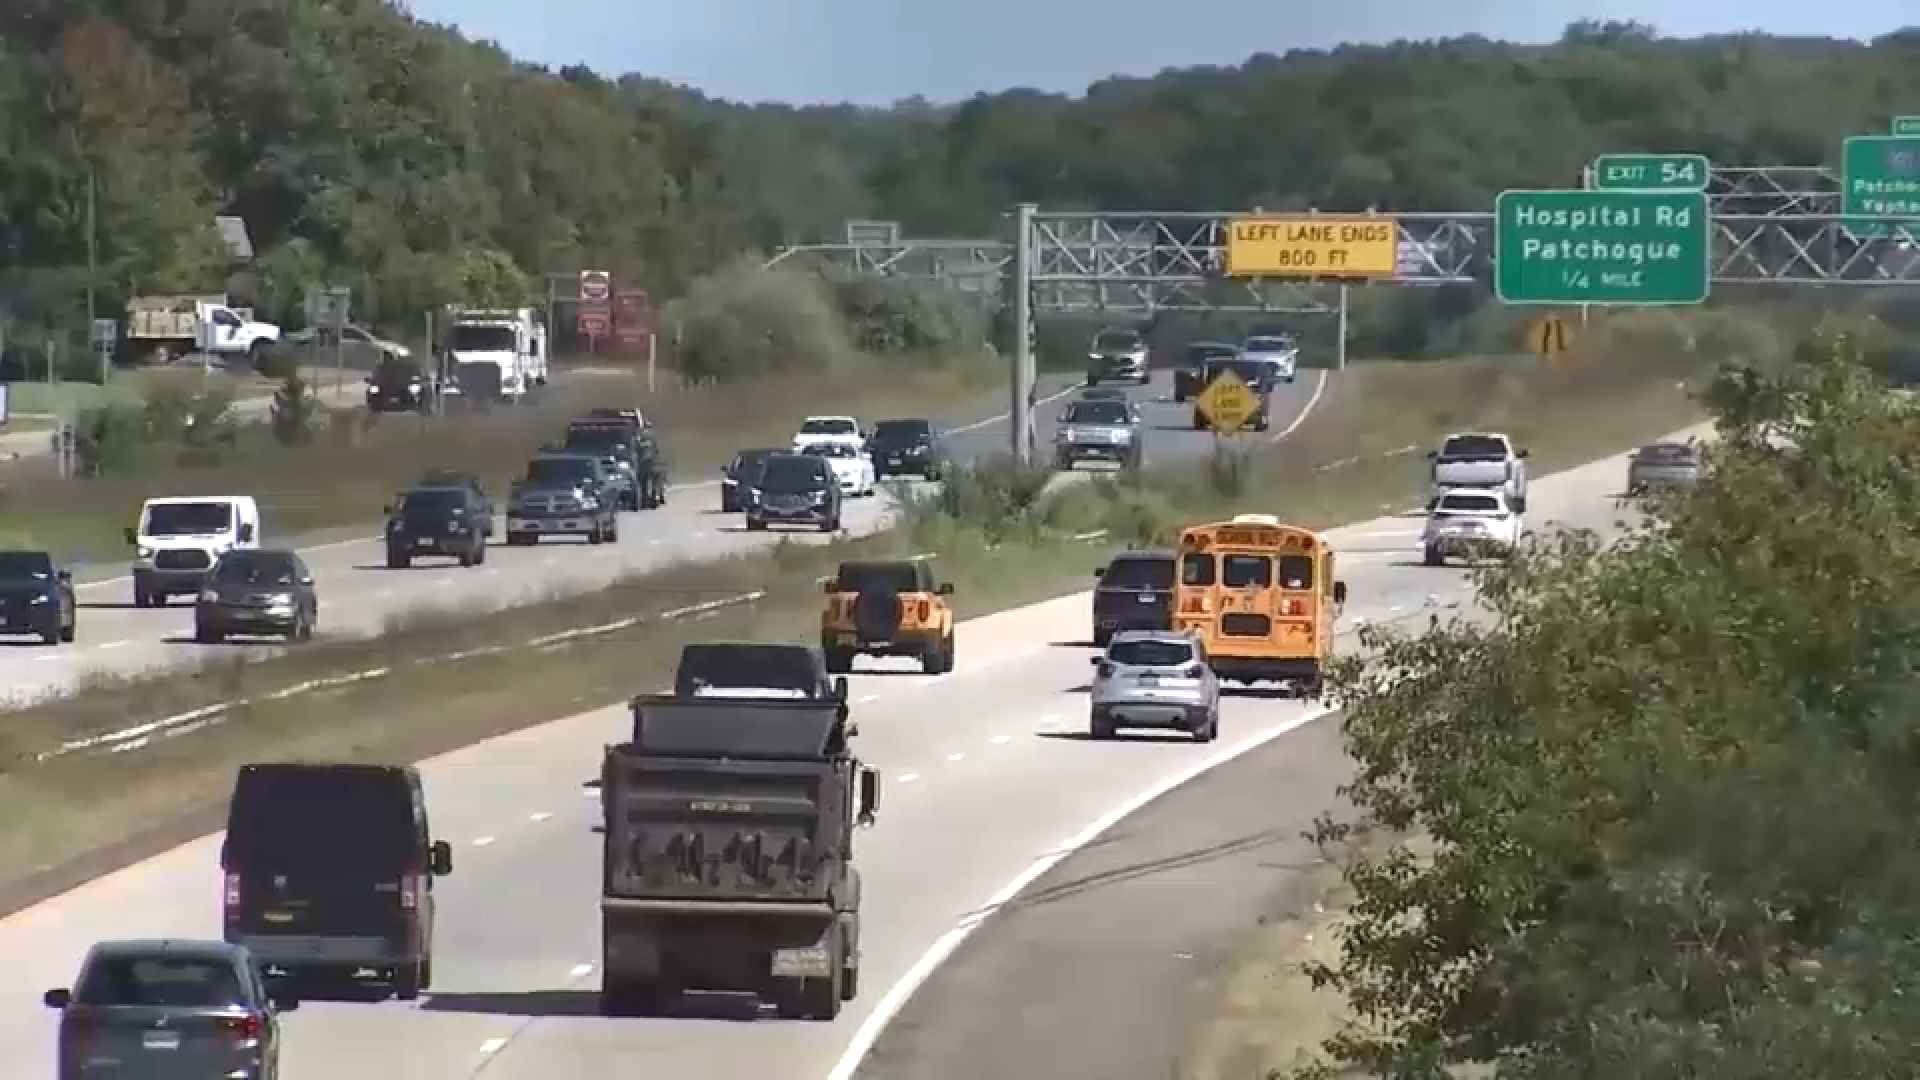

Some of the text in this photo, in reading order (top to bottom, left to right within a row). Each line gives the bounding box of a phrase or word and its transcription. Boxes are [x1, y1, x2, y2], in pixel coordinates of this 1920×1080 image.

[1606, 162, 1696, 183] EXIT 54
[1515, 205, 1691, 231] Hospital Rd
[1236, 225, 1389, 242] LEFT LANE ENDS
[1279, 249, 1348, 266] 800 FT
[1522, 239, 1682, 265] Patchogue
[1600, 271, 1645, 288] MILE
